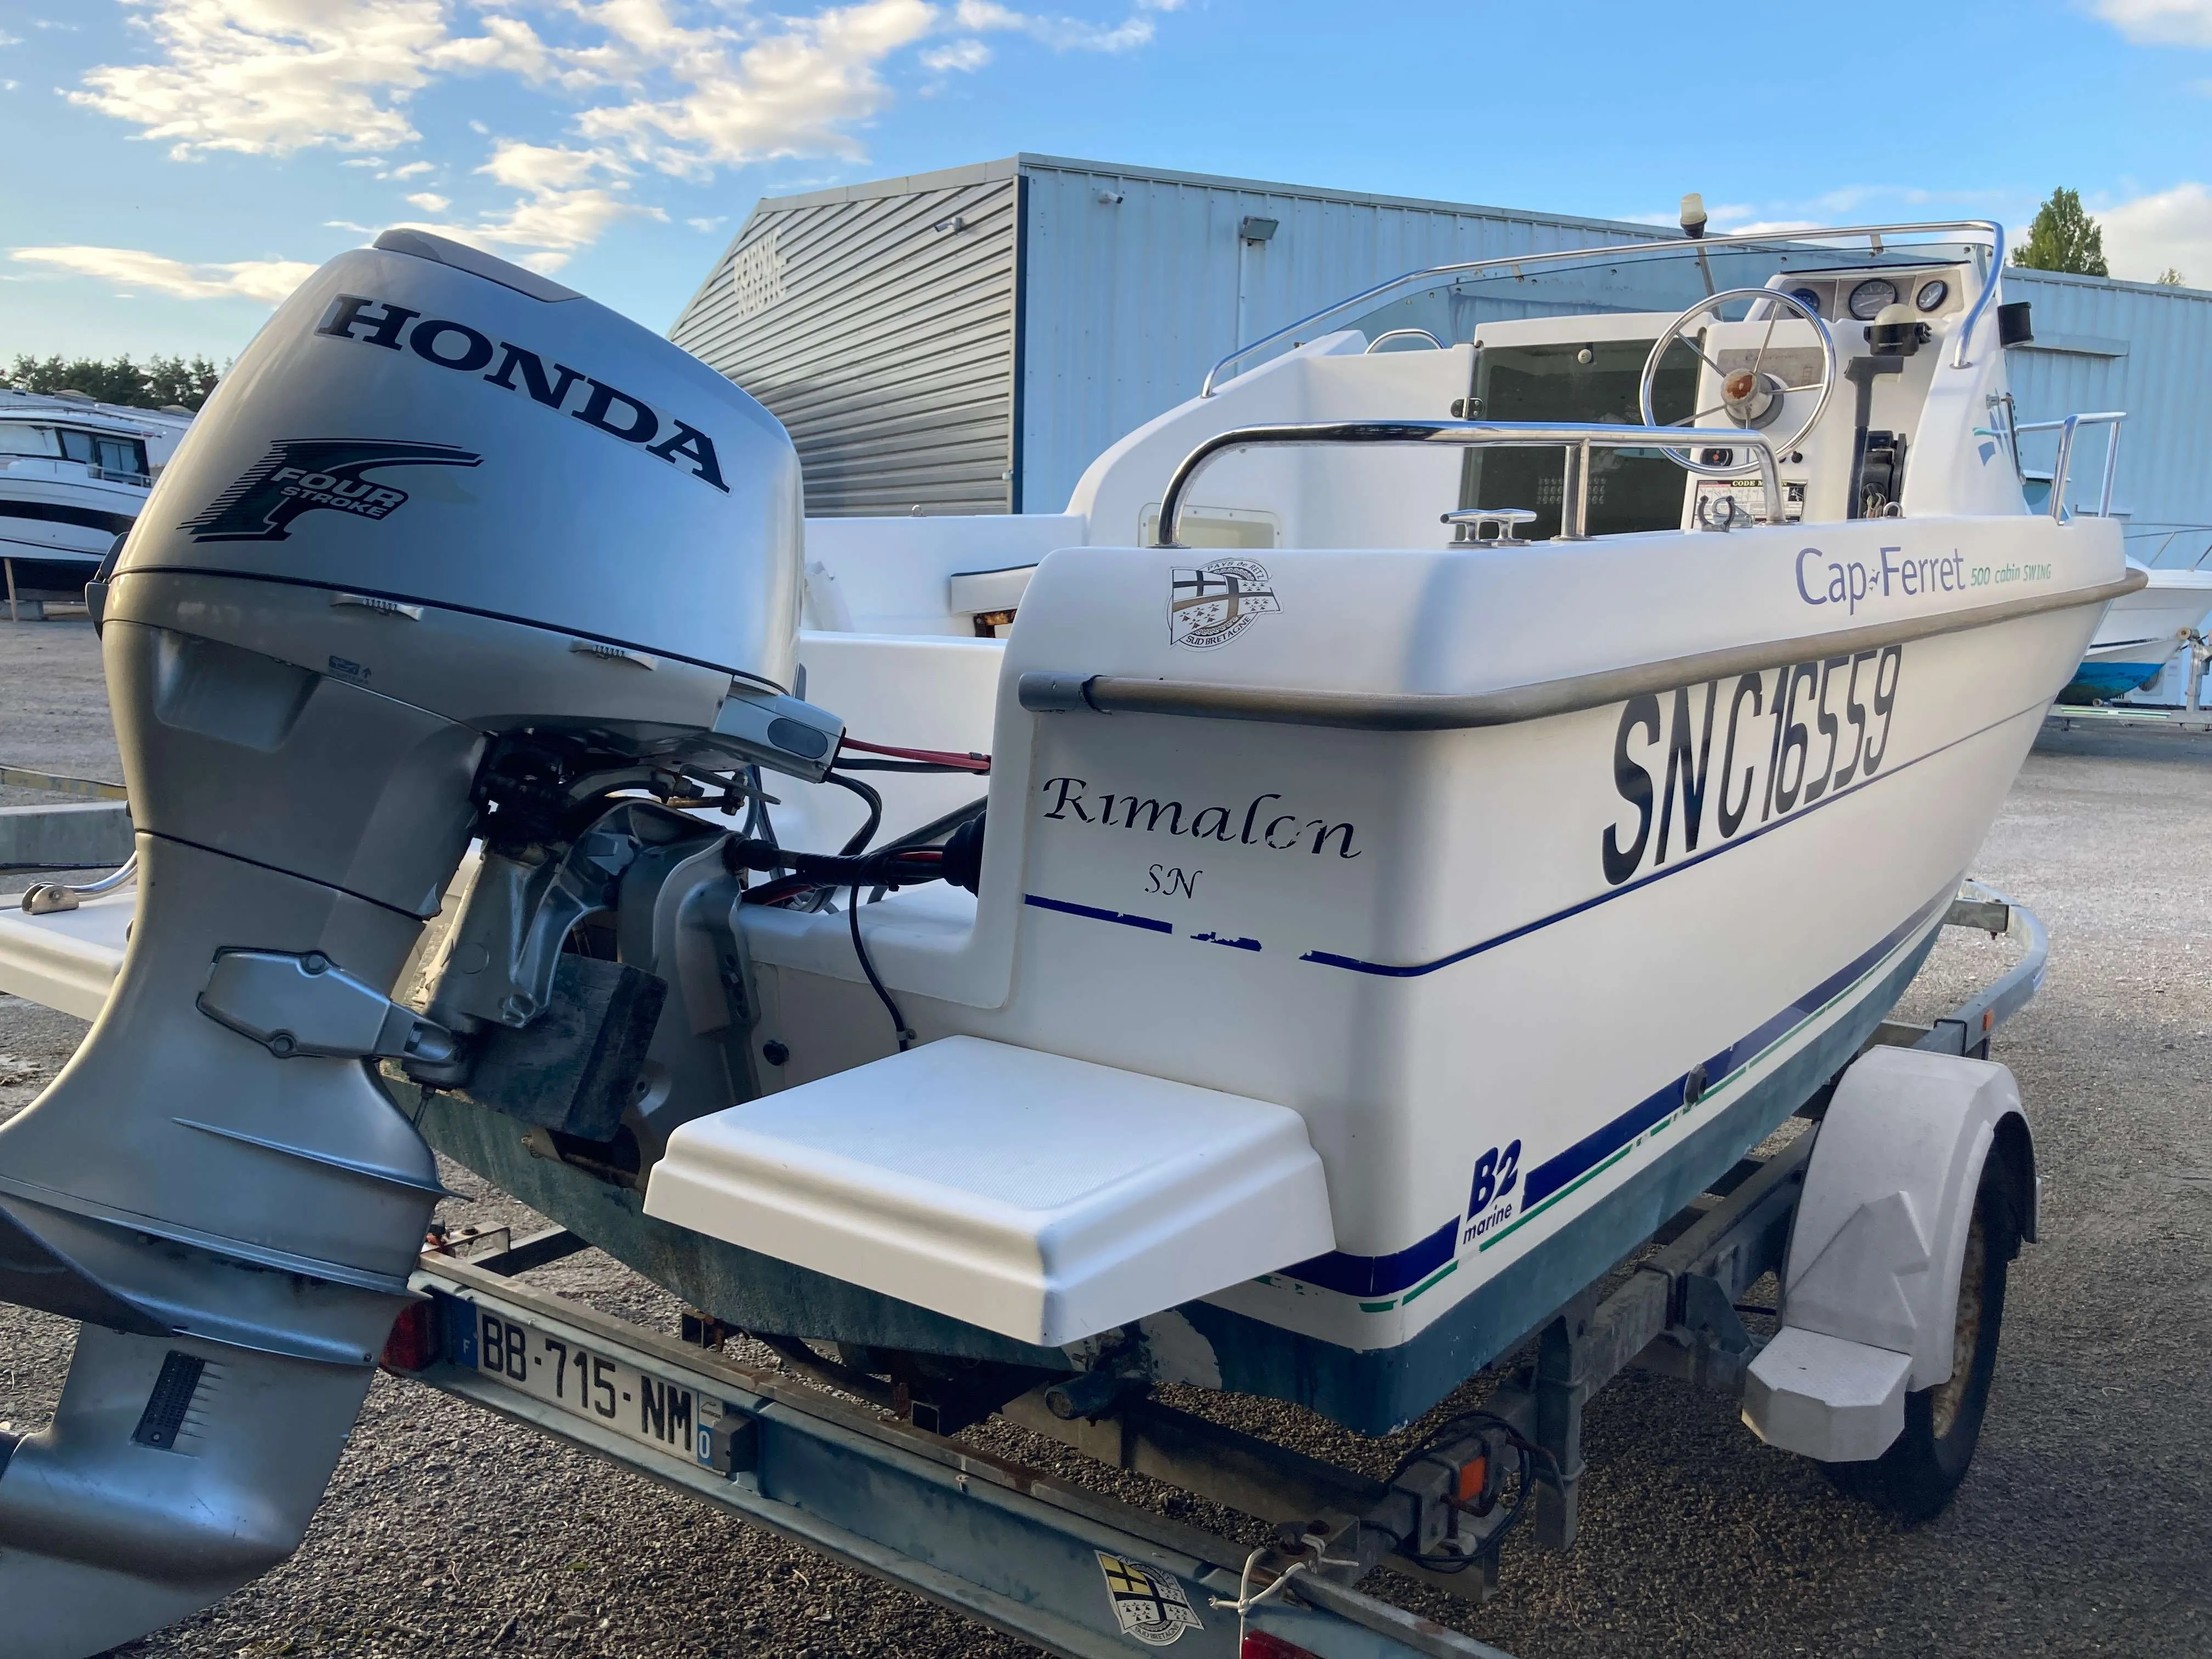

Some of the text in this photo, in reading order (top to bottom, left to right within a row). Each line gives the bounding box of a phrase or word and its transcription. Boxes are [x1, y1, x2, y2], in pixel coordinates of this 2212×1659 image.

[317, 295, 731, 494] HONDA
[270, 466, 409, 508] FOUR
[280, 486, 387, 518] STROKE
[1207, 561, 1234, 571] PAYS
[1248, 564, 1264, 580] RETZ
[1971, 567, 1991, 586] 500
[1995, 563, 2020, 584] cabin
[2023, 563, 2051, 582] SWING
[1186, 616, 1251, 645] SUD BRETAGNE
[1602, 645, 1902, 885] SNC16559
[1144, 864, 1203, 899] SN
[1466, 1138, 1522, 1223] B2
[1462, 1203, 1513, 1245] marine
[482, 1313, 691, 1452] BB-715-NM
